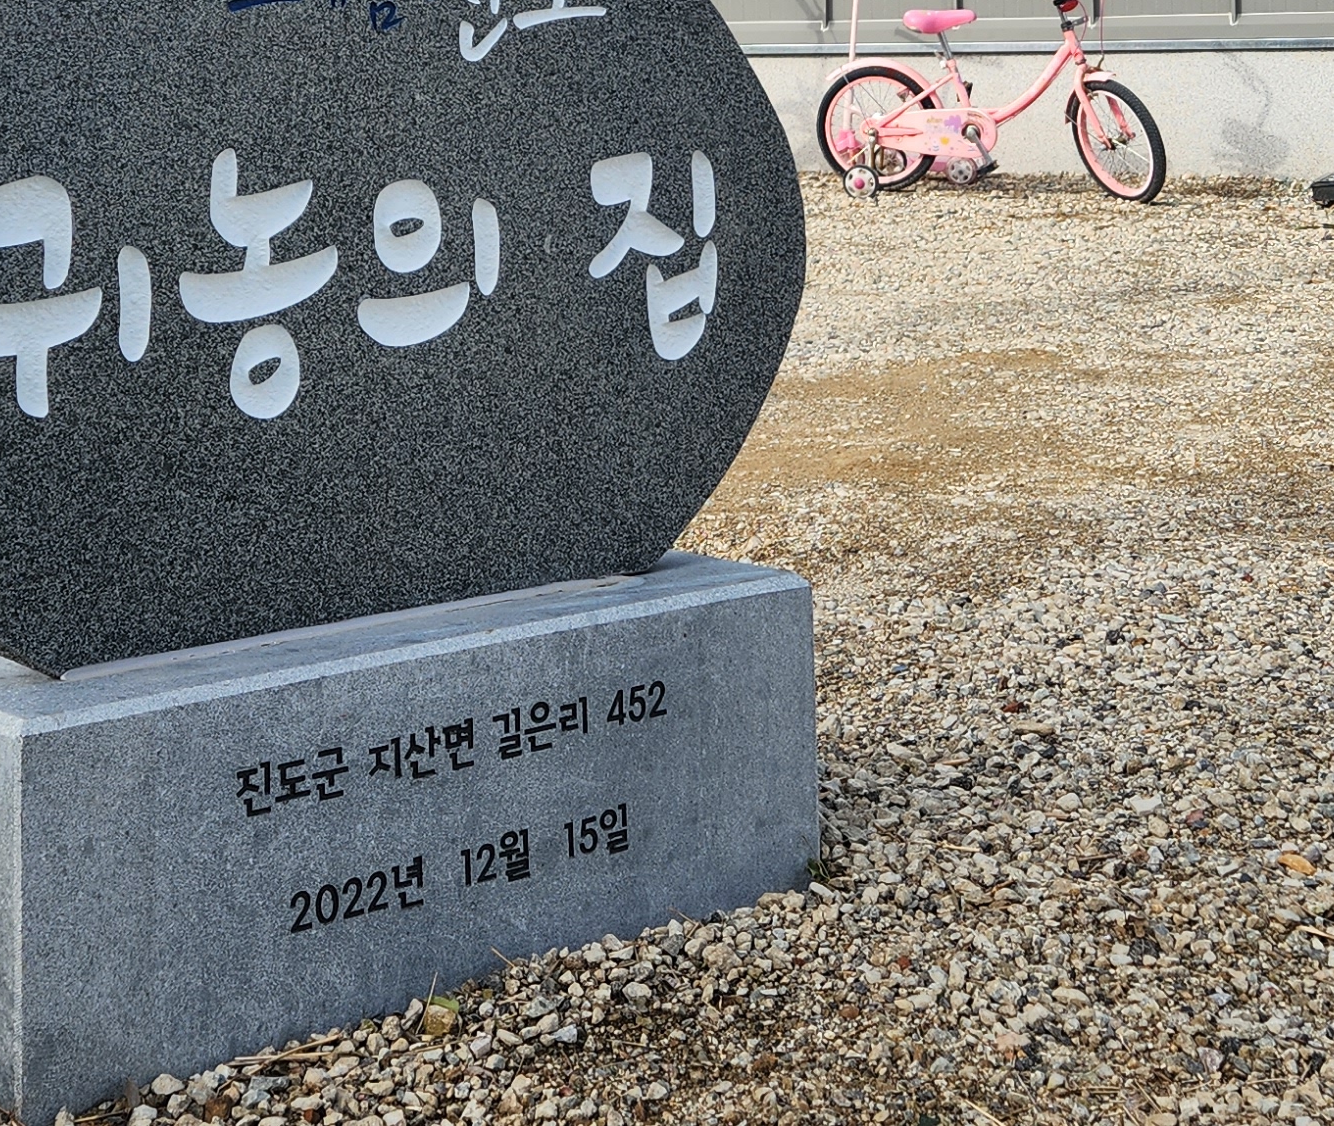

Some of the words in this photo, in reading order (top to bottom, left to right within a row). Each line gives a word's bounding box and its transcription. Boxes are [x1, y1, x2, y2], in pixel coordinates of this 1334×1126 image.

[589, 151, 718, 361] 집
[236, 746, 350, 818] 진도군
[368, 717, 475, 779] 지산면
[492, 696, 590, 760] 길은리
[606, 680, 668, 726] 452
[289, 854, 425, 934] 2022년
[460, 828, 532, 887] 12월
[563, 802, 630, 858] 15일
